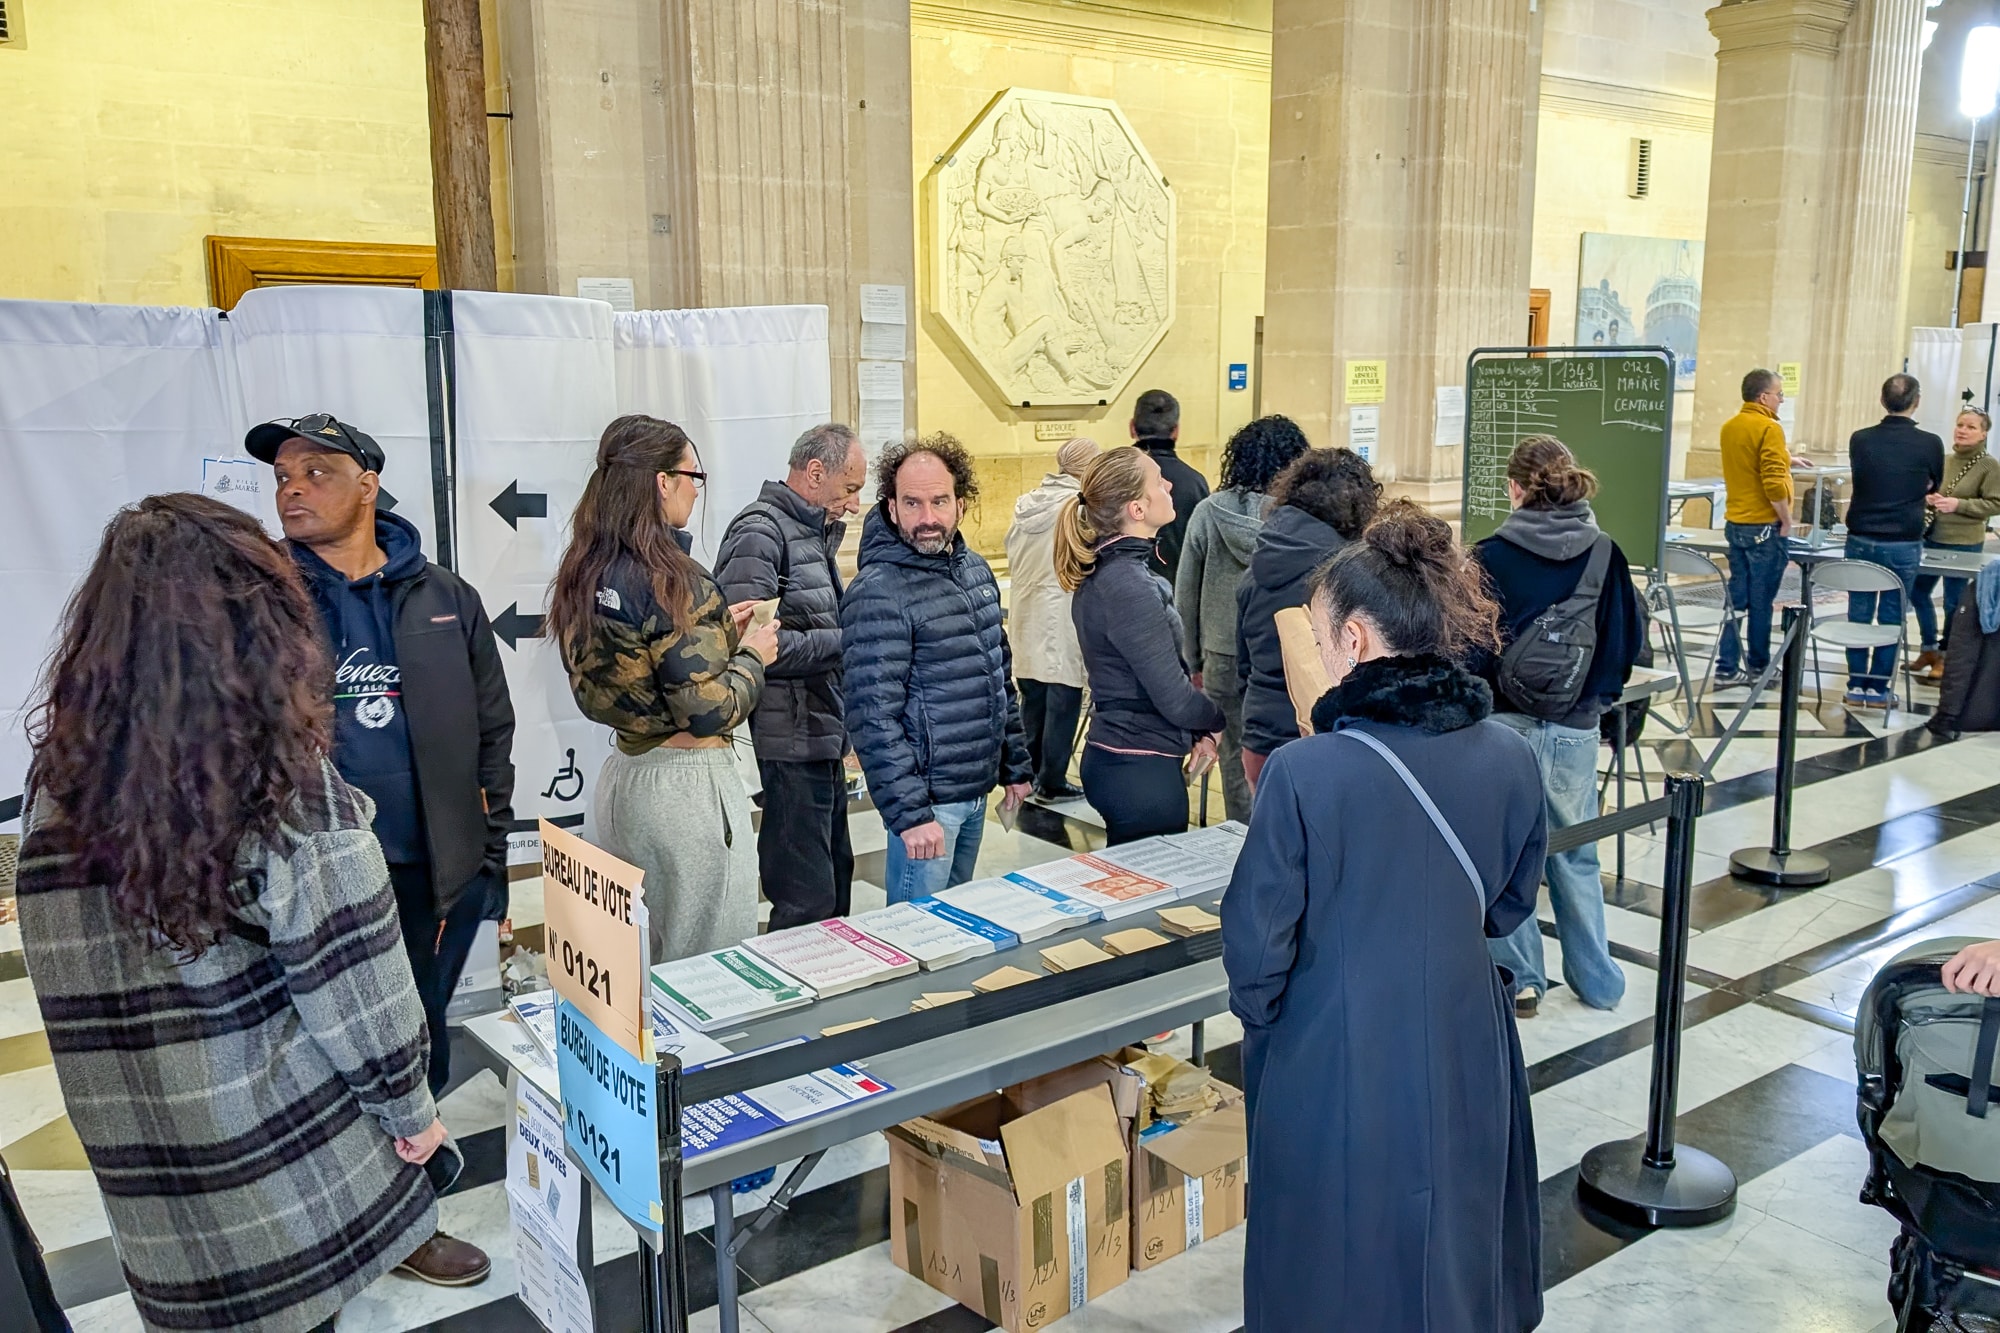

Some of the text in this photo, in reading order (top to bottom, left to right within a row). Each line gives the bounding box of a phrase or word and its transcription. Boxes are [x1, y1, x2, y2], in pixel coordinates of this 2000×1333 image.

[1556, 361, 1594, 380] 1349
[1622, 361, 1652, 374] 0121
[235, 484, 261, 493] MARSE
[543, 839, 632, 926] BUREAU DE VOTE
[549, 926, 558, 962] N°
[563, 940, 611, 1006] 0121
[561, 1011, 594, 1076] BUREAU
[596, 1048, 609, 1091] DE
[611, 1062, 647, 1117] VOTE
[519, 1121, 567, 1178] DEUX VOTES
[577, 1109, 621, 1184] 0121
[1094, 1224, 1122, 1258] 1/3
